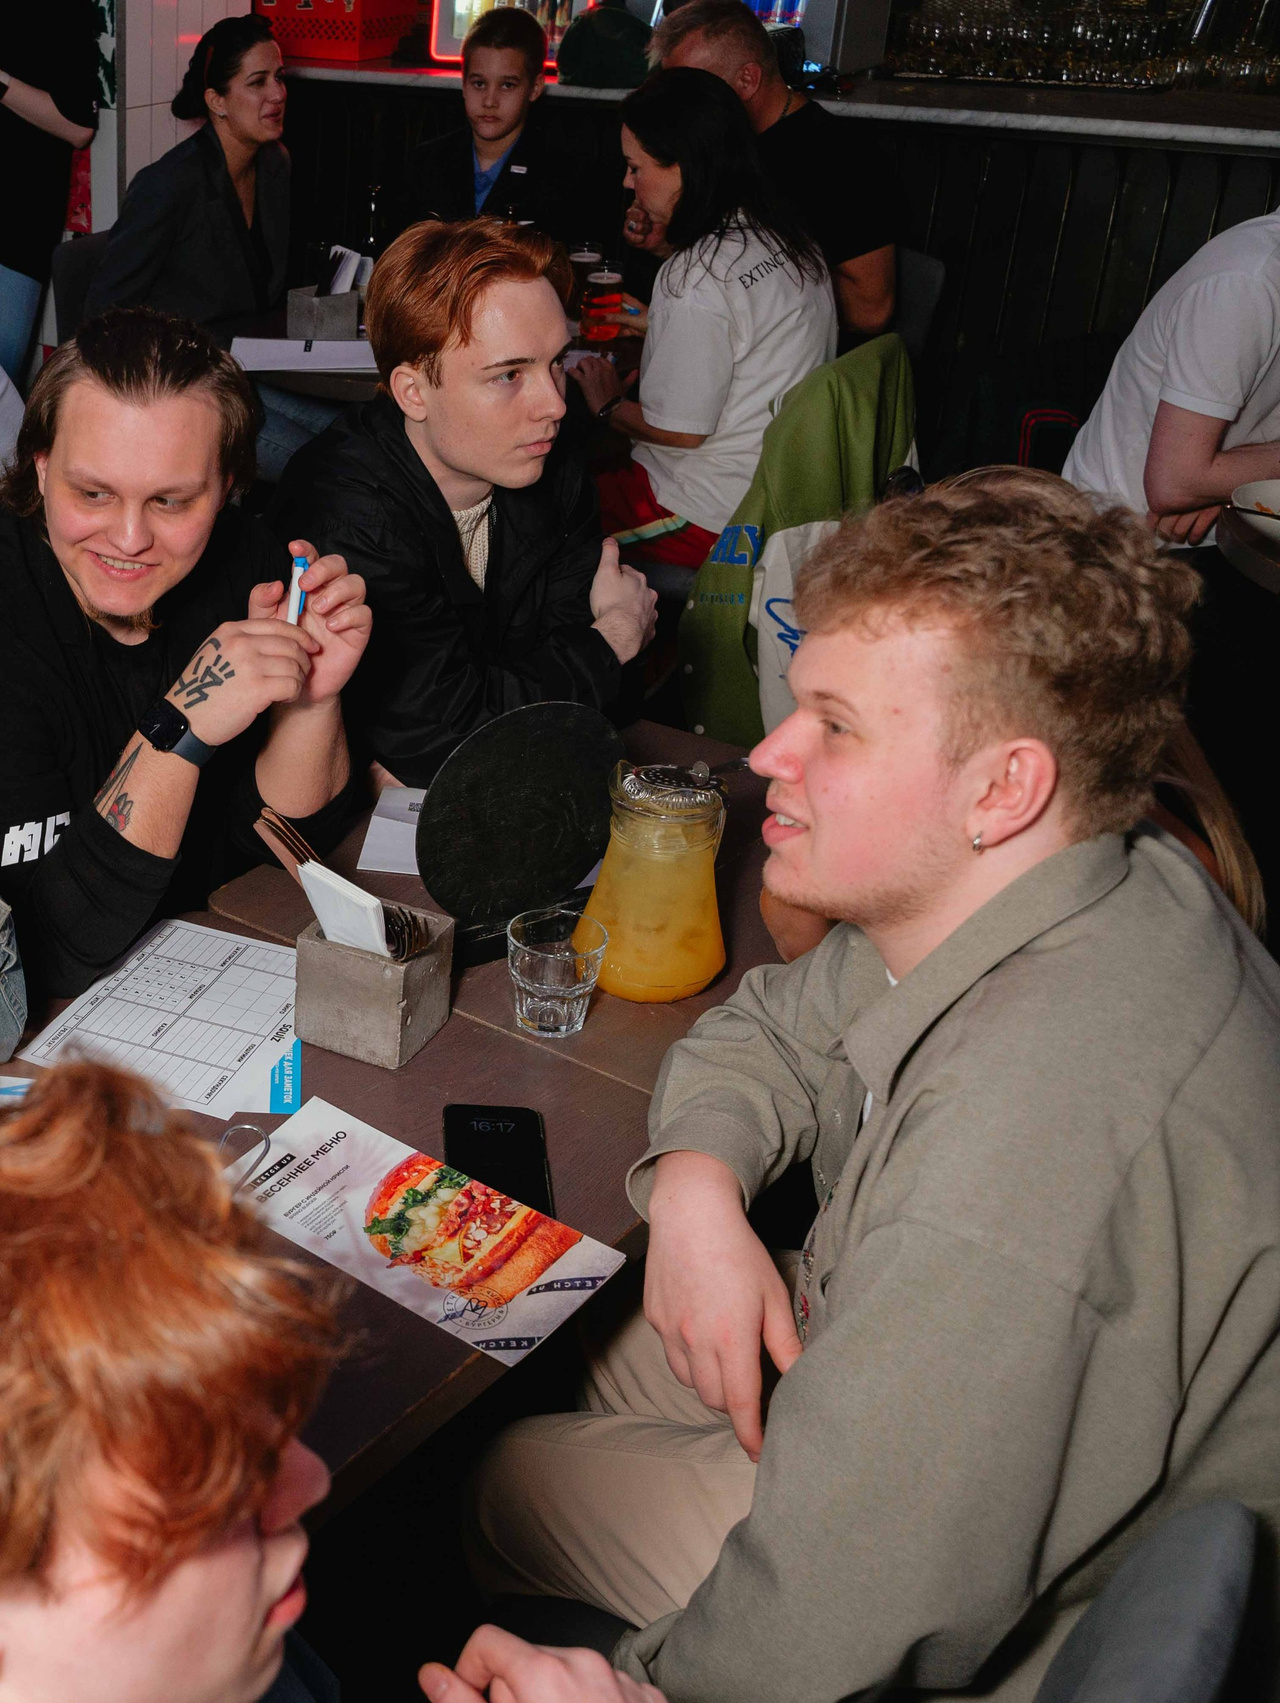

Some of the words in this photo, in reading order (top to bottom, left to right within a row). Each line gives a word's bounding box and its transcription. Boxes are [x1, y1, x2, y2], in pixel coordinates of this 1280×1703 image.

[283, 1061, 293, 1075] ДЛЯ
[283, 1076, 293, 1104] ЗАМЕТОК
[469, 1120, 516, 1133] 16:17
[255, 1158, 316, 1204] ВЕСЕННЕЕ
[310, 1130, 347, 1160] МЕНЮ
